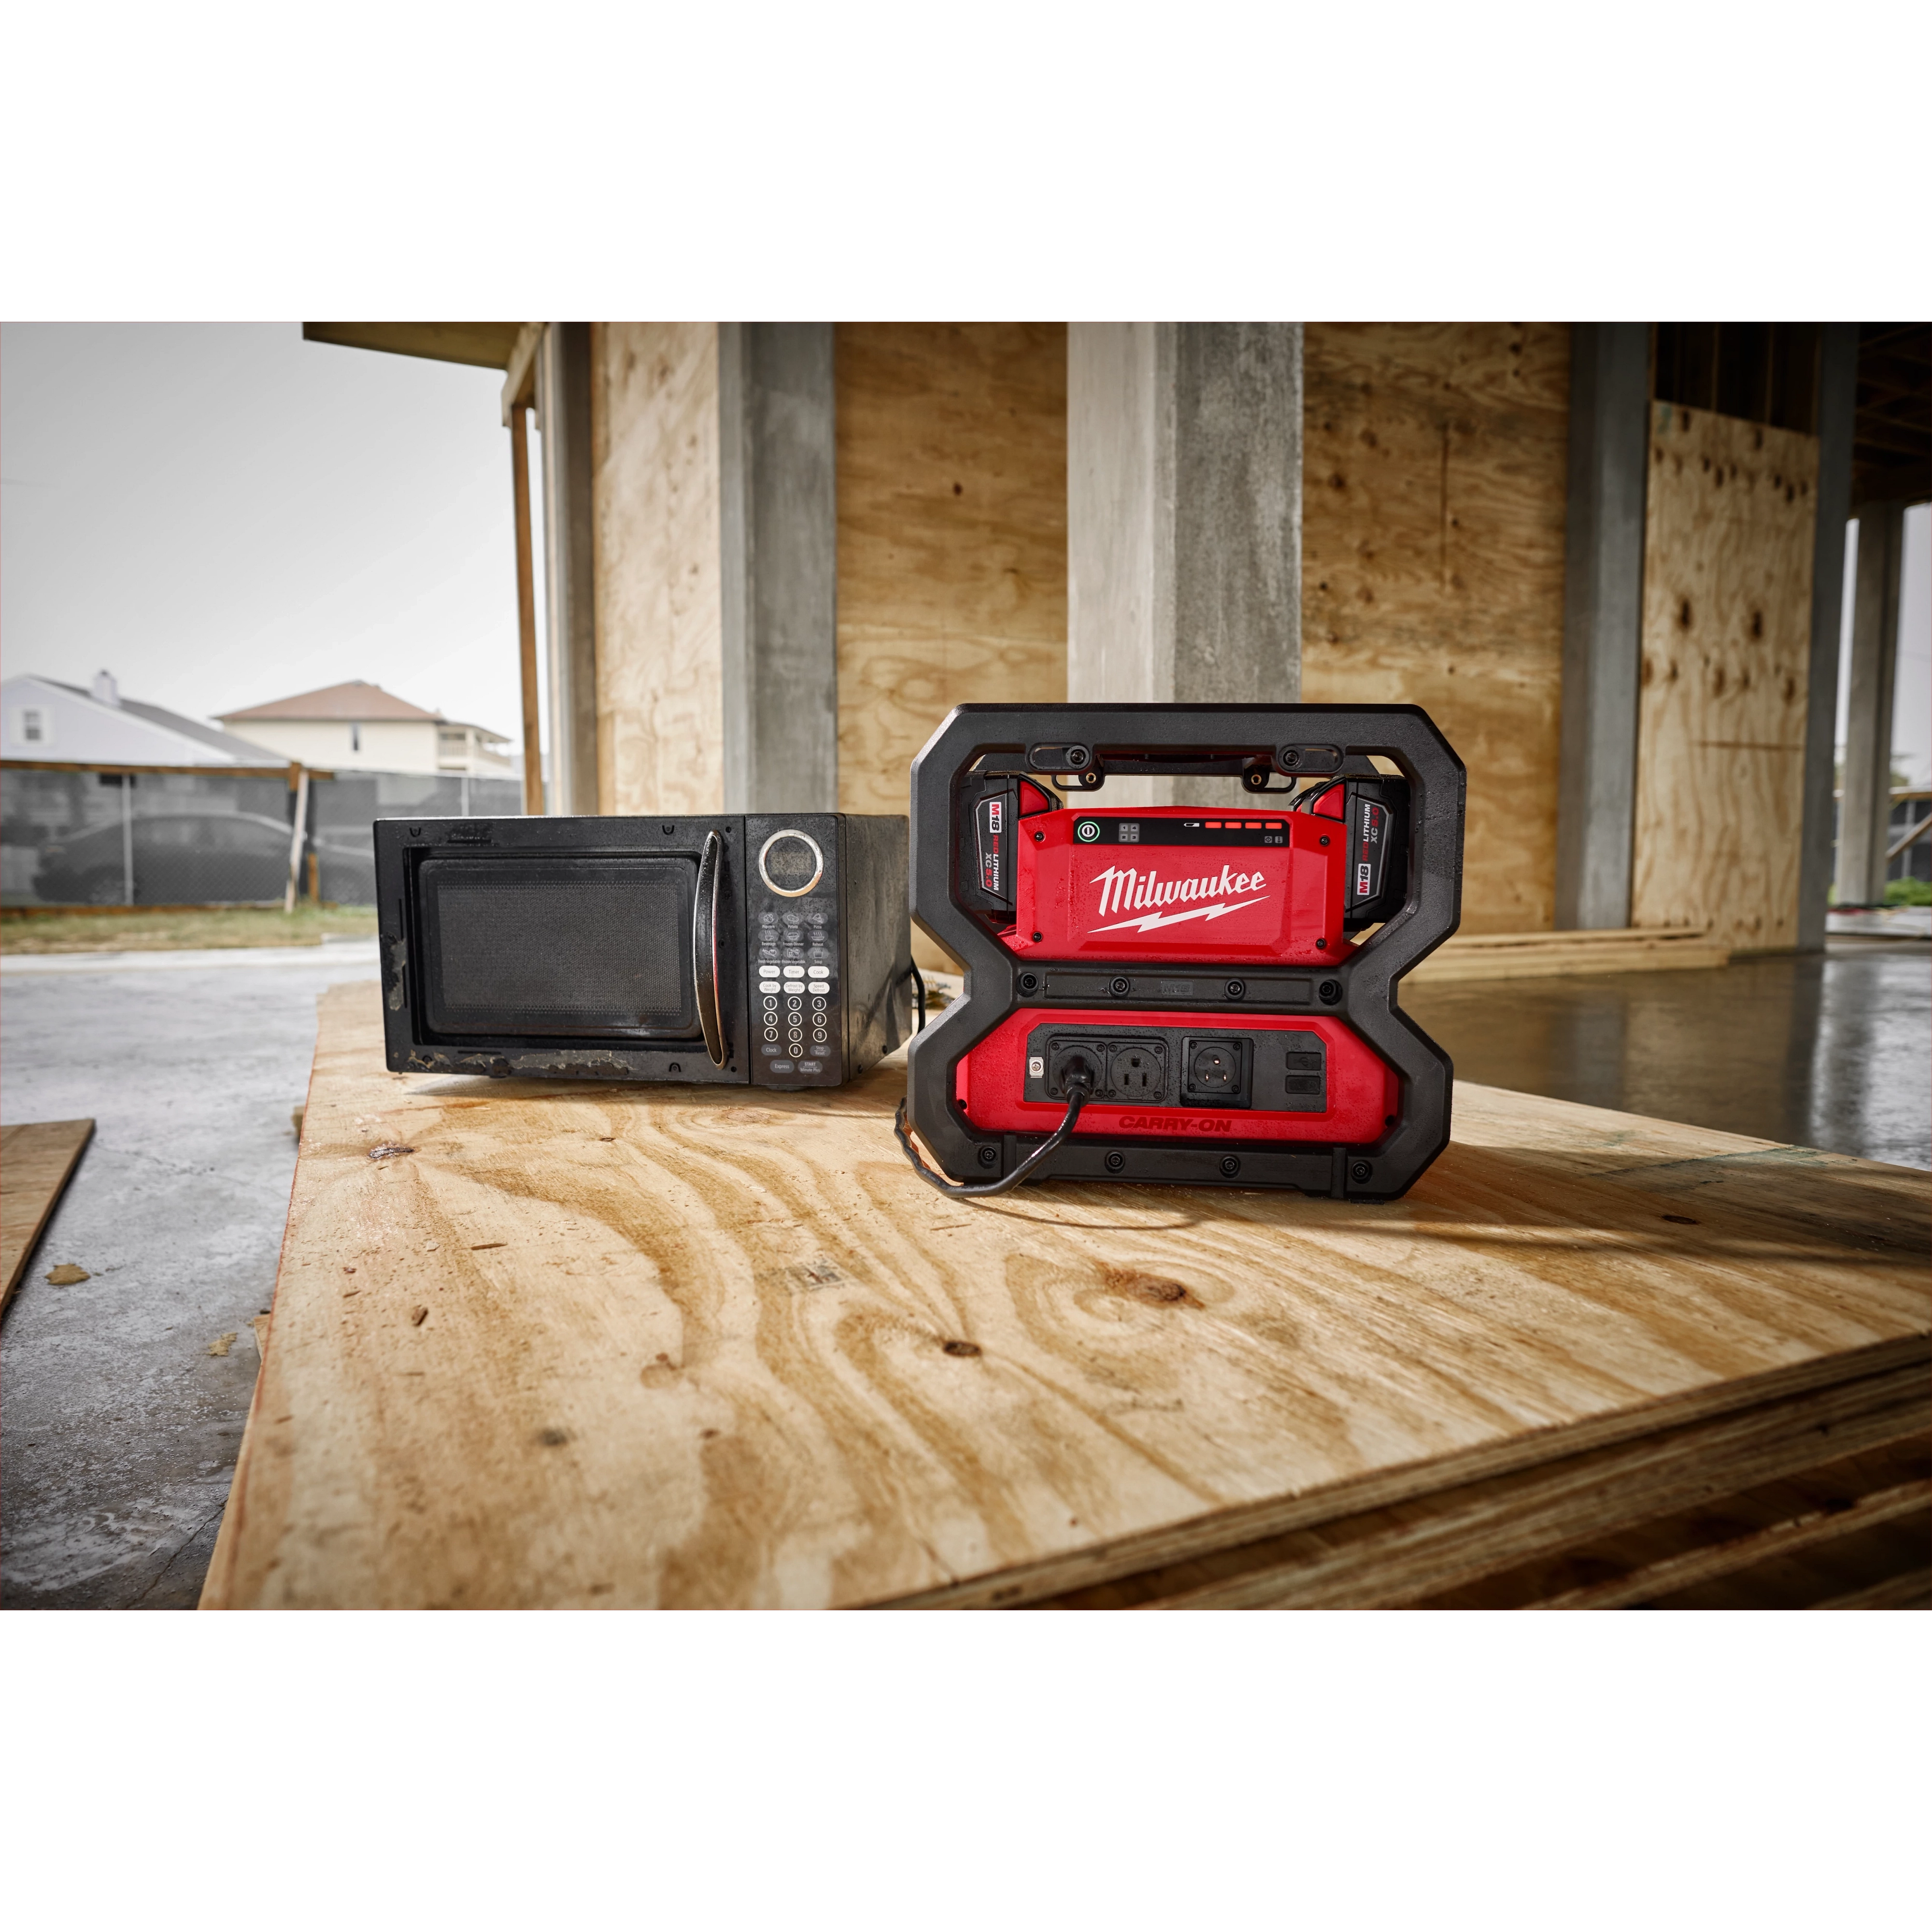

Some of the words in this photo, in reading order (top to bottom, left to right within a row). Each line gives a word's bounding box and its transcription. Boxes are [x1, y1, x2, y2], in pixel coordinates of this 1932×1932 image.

[992, 804, 1000, 831] M18
[1362, 804, 1371, 862] REDLITHIUM
[1089, 865, 1267, 917] Milwaukee
[1359, 865, 1369, 894] M18
[1119, 1116, 1232, 1132] CARRY-ON
